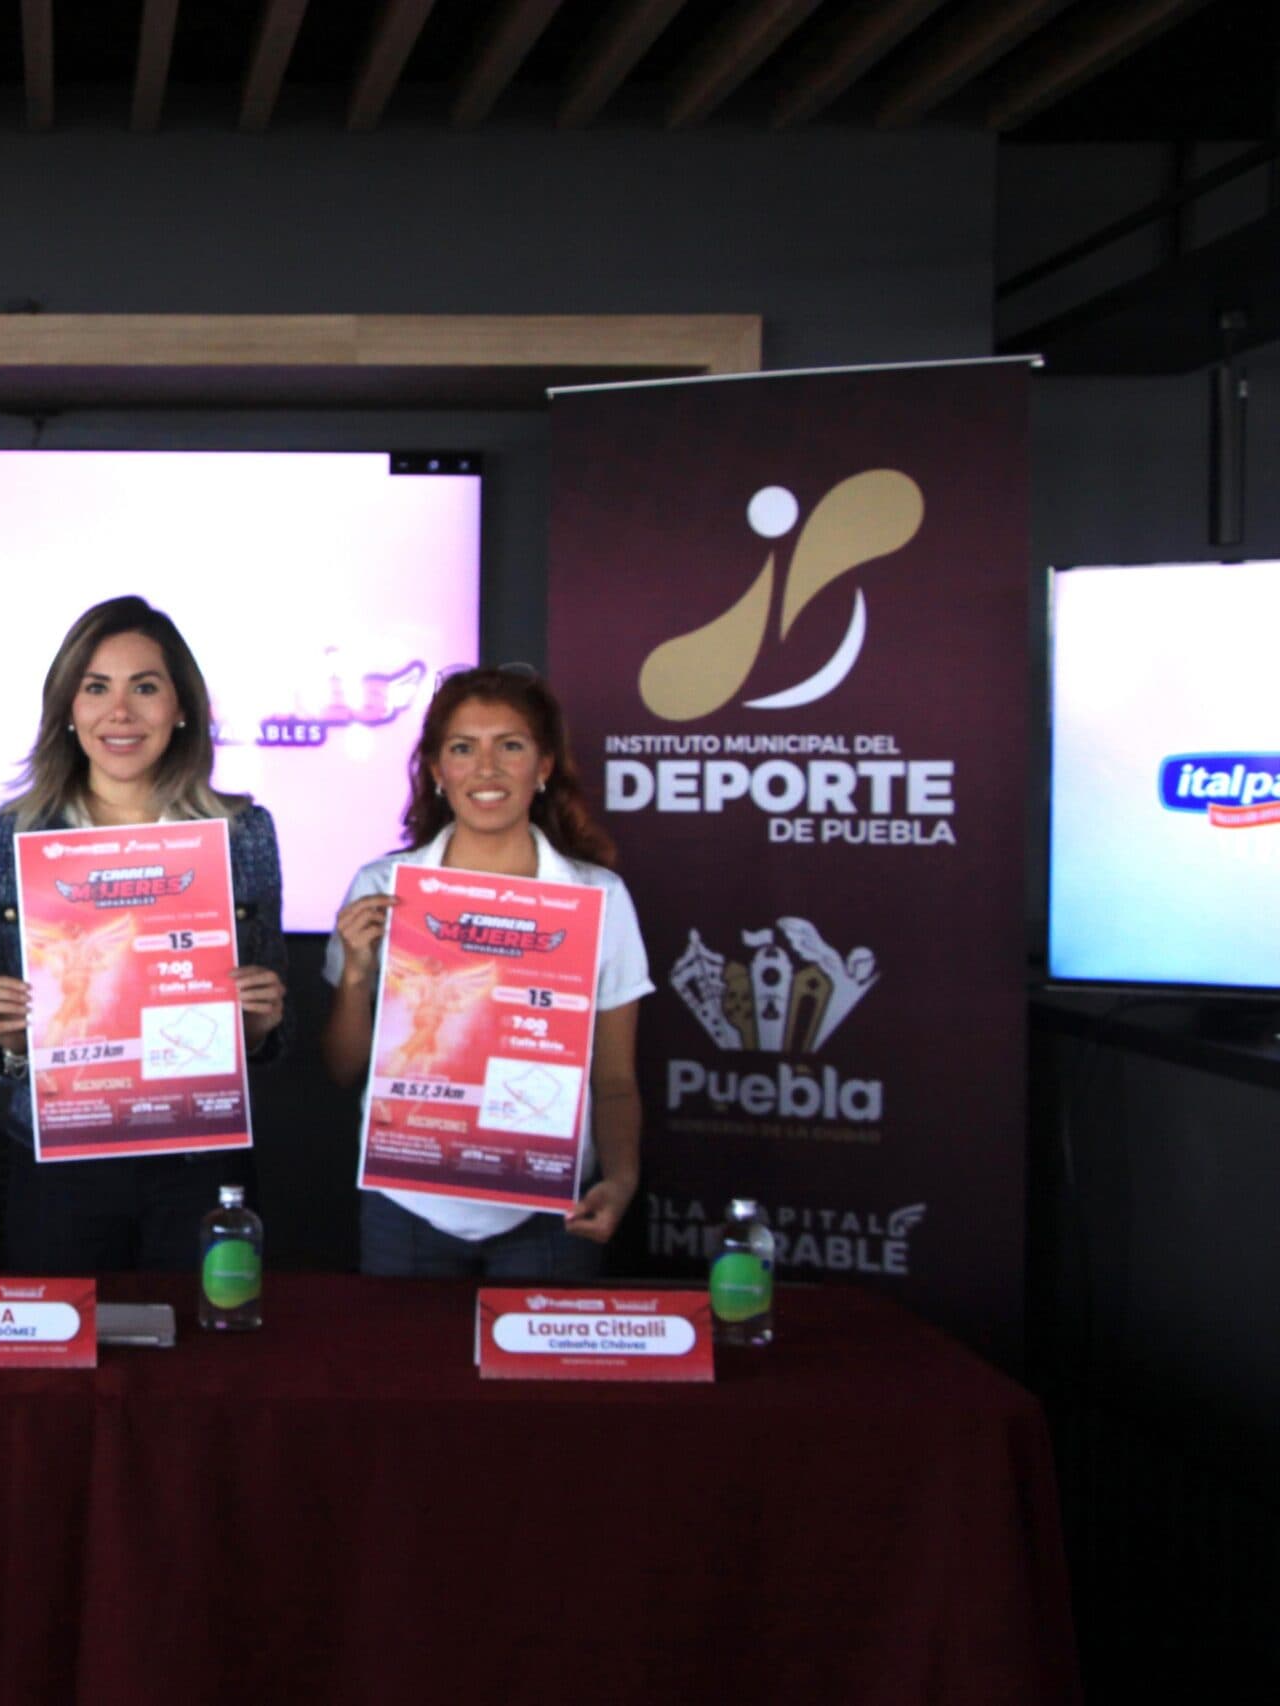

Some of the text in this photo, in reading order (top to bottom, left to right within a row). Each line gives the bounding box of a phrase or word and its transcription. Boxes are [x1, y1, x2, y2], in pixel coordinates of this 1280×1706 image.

[605, 735, 900, 754] INSTITUTO MUNICIPAL DEL
[605, 759, 955, 815] DEPORTE
[769, 818, 956, 845] DE PUEBLA
[72, 878, 181, 900] MUJERES
[169, 931, 193, 950] 15
[439, 922, 552, 950] MUJERES
[529, 989, 553, 1008] 15
[667, 1059, 882, 1122] Puebla
[664, 1201, 706, 1220] LA
[528, 1319, 666, 1338] Laura Citlalli
